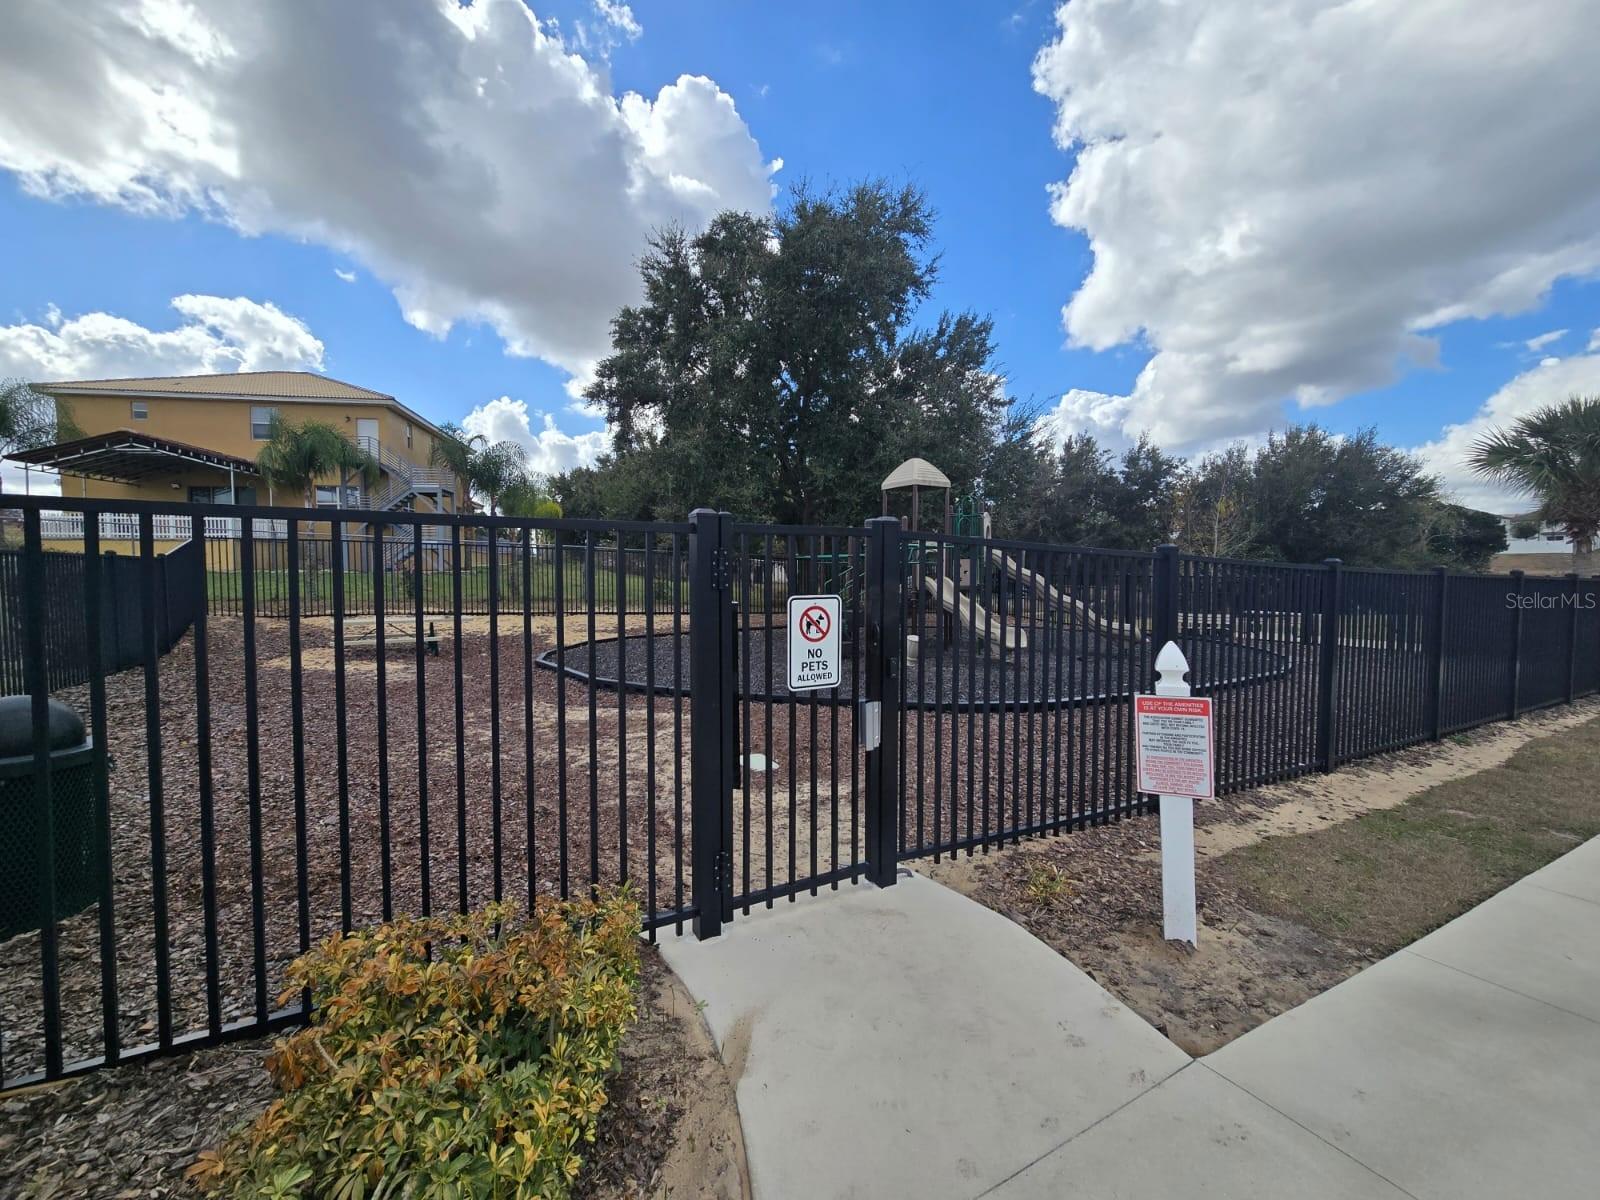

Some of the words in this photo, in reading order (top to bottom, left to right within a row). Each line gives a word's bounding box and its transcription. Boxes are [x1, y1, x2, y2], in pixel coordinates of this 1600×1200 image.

[808, 648, 822, 658] NO
[802, 660, 828, 672] PETS
[798, 672, 832, 682] ALLOWED
